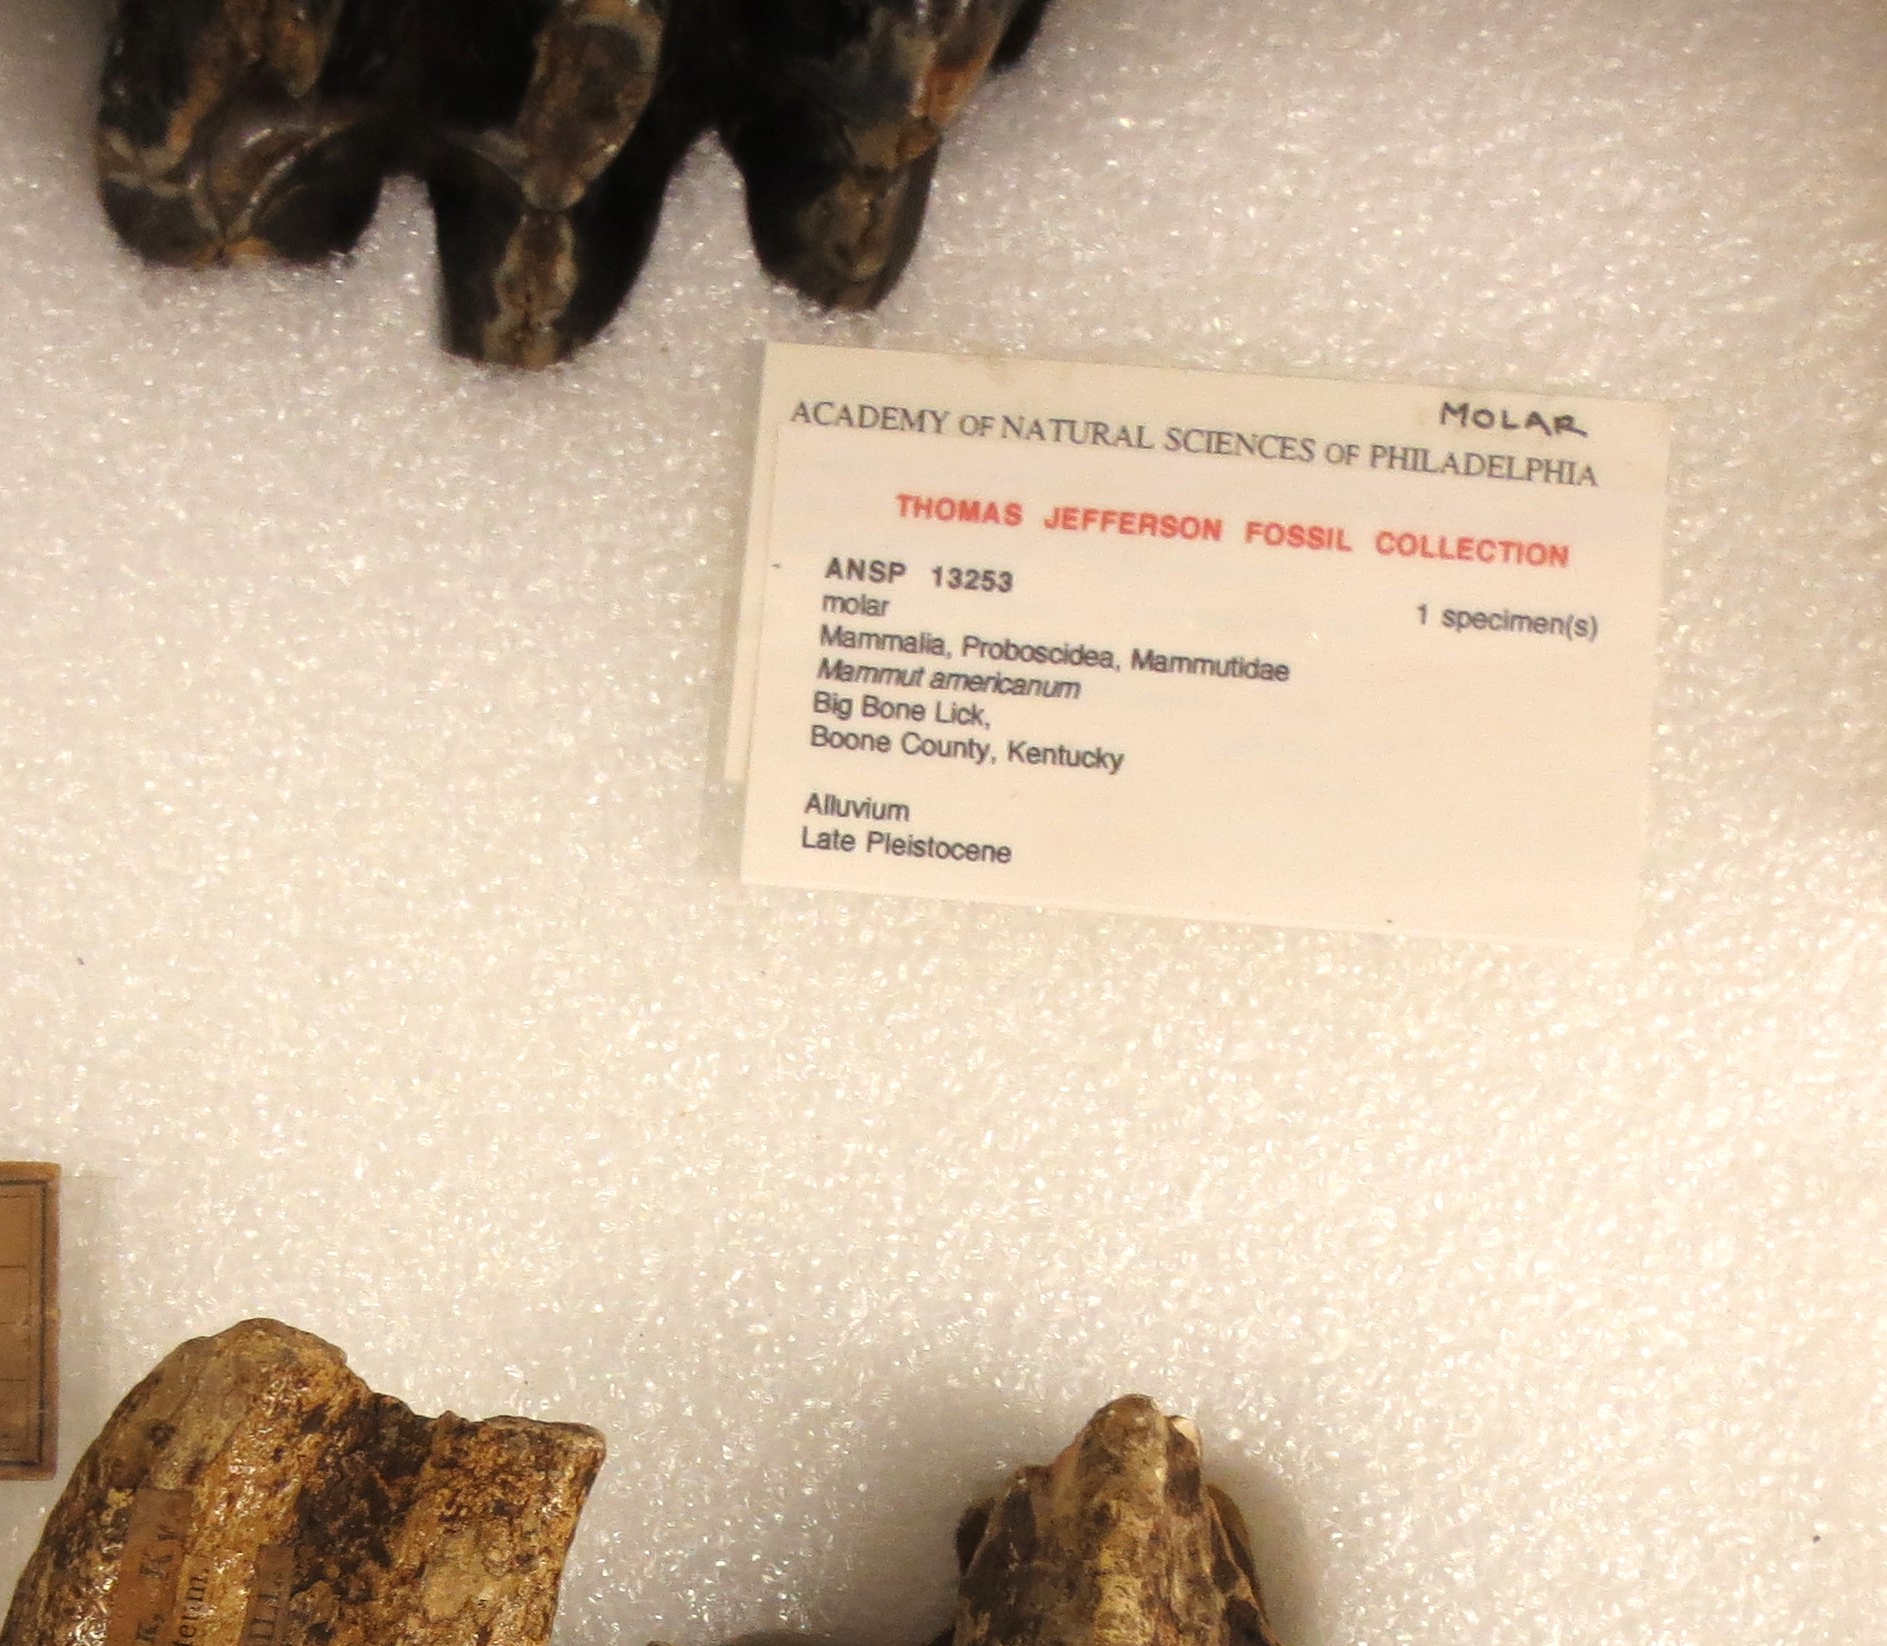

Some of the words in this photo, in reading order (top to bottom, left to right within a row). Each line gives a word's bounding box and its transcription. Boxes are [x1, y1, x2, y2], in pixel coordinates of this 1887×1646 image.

[1438, 400, 1589, 438] MOLAR
[790, 400, 950, 434] ACADEMY
[958, 413, 994, 437] OF
[1001, 414, 1154, 450] NATURAL
[1163, 427, 1317, 464] SCIENCES
[1324, 442, 1360, 466] OF
[1369, 443, 1600, 488] PHILADELPHIA
[896, 493, 1023, 527] THOMAS
[1043, 506, 1223, 542] JEFFERSON
[1245, 519, 1352, 552] FOSSIL
[1375, 529, 1570, 568] COLLECTION
[824, 556, 906, 584] ANSP
[931, 565, 1013, 593] 13253
[821, 592, 890, 618] molar
[1416, 603, 1429, 625] 1
[1441, 607, 1599, 642] specimen(s)
[819, 624, 953, 660] Mammalia,
[961, 634, 1121, 672] Proboscidea,
[1130, 648, 1291, 682] Mammutidae
[816, 657, 926, 688] Mammut
[930, 668, 1082, 700] americanum
[813, 691, 853, 721] Big
[861, 695, 926, 723] Bone
[935, 700, 991, 730] Lick,
[810, 724, 892, 755] Boone
[901, 731, 997, 766] County,
[1007, 740, 1125, 775] Kentucky
[803, 791, 910, 822] Alluvium
[801, 826, 856, 853] Late
[866, 831, 1012, 865] Pleistocene
